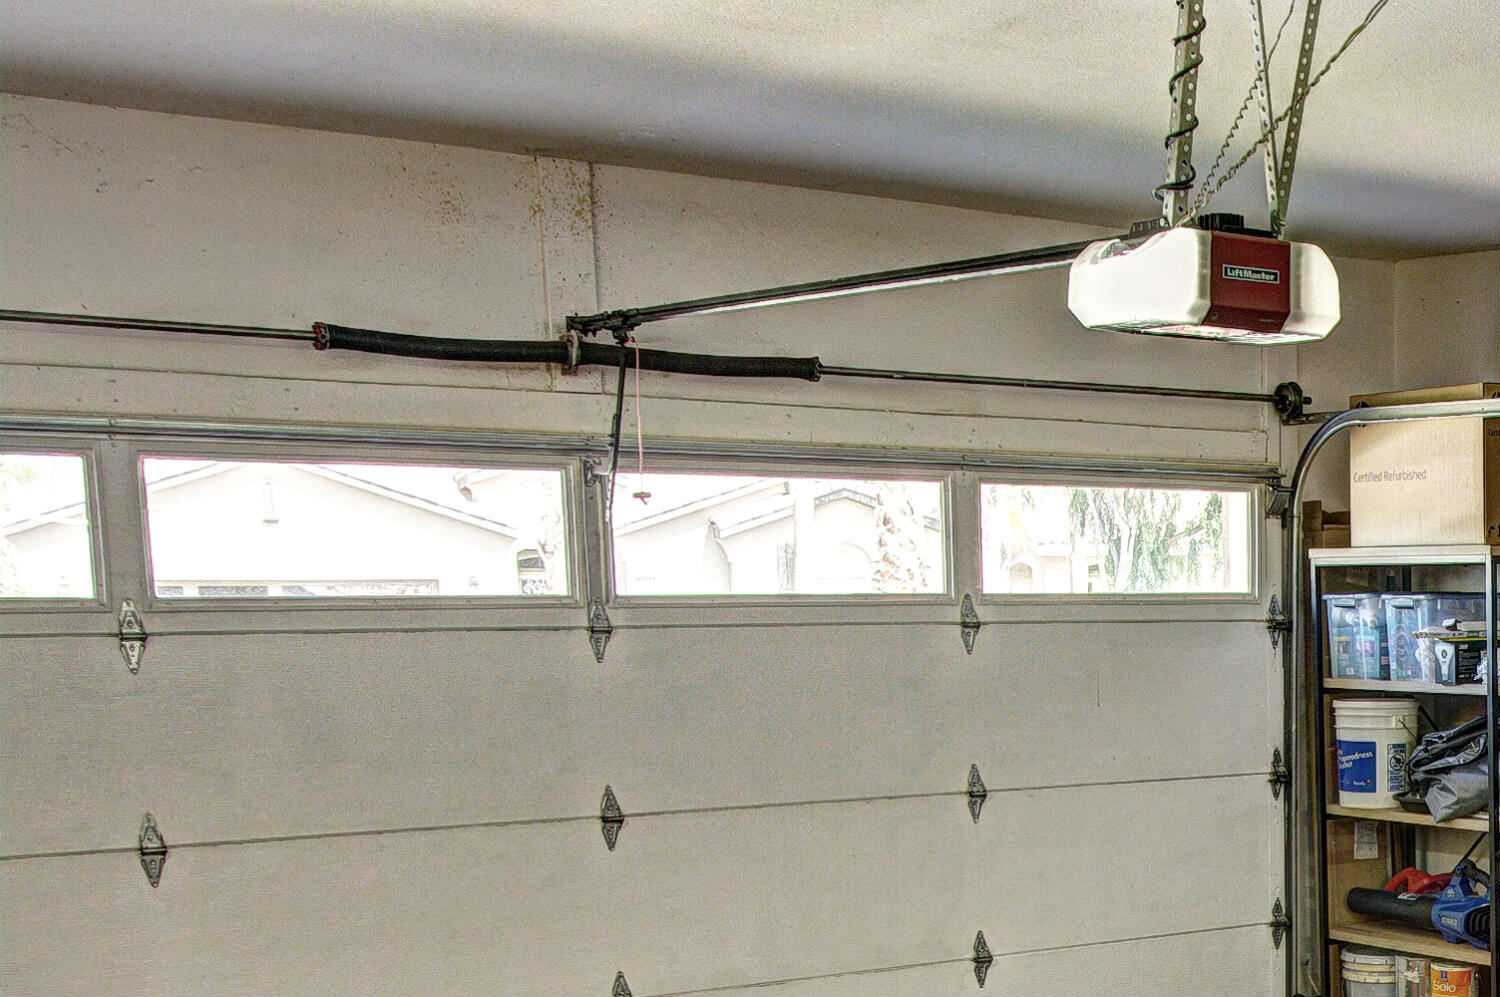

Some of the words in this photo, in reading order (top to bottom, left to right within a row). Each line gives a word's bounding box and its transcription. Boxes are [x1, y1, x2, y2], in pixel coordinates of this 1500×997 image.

[1227, 267, 1276, 281] LiftMaster
[1353, 471, 1382, 483] Certified
[1384, 467, 1427, 481] Refurbished
[1432, 980, 1457, 993] Solo
